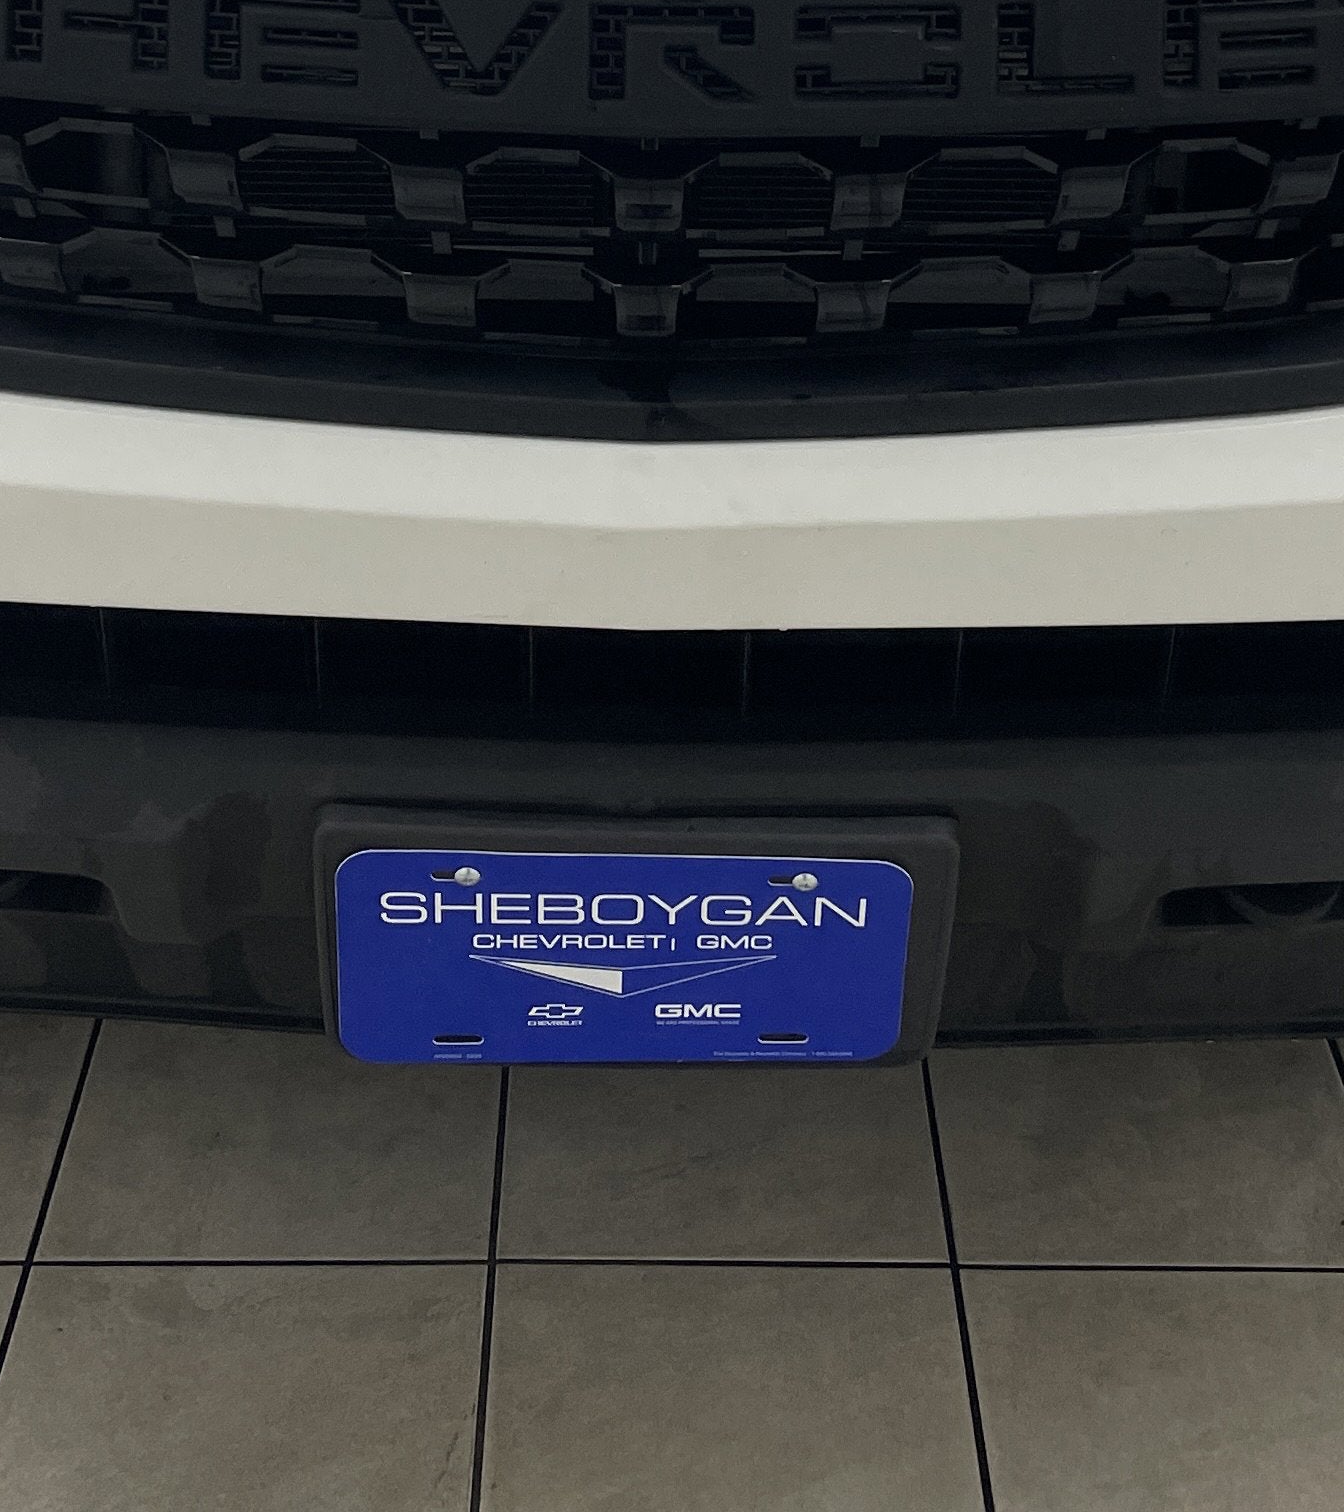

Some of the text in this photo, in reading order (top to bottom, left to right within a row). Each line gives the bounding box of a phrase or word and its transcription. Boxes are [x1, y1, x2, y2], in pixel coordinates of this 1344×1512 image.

[380, 891, 867, 928] SHEBOYGAN
[472, 933, 773, 950] CHEVROLET GMC
[655, 1003, 742, 1018] GMC
